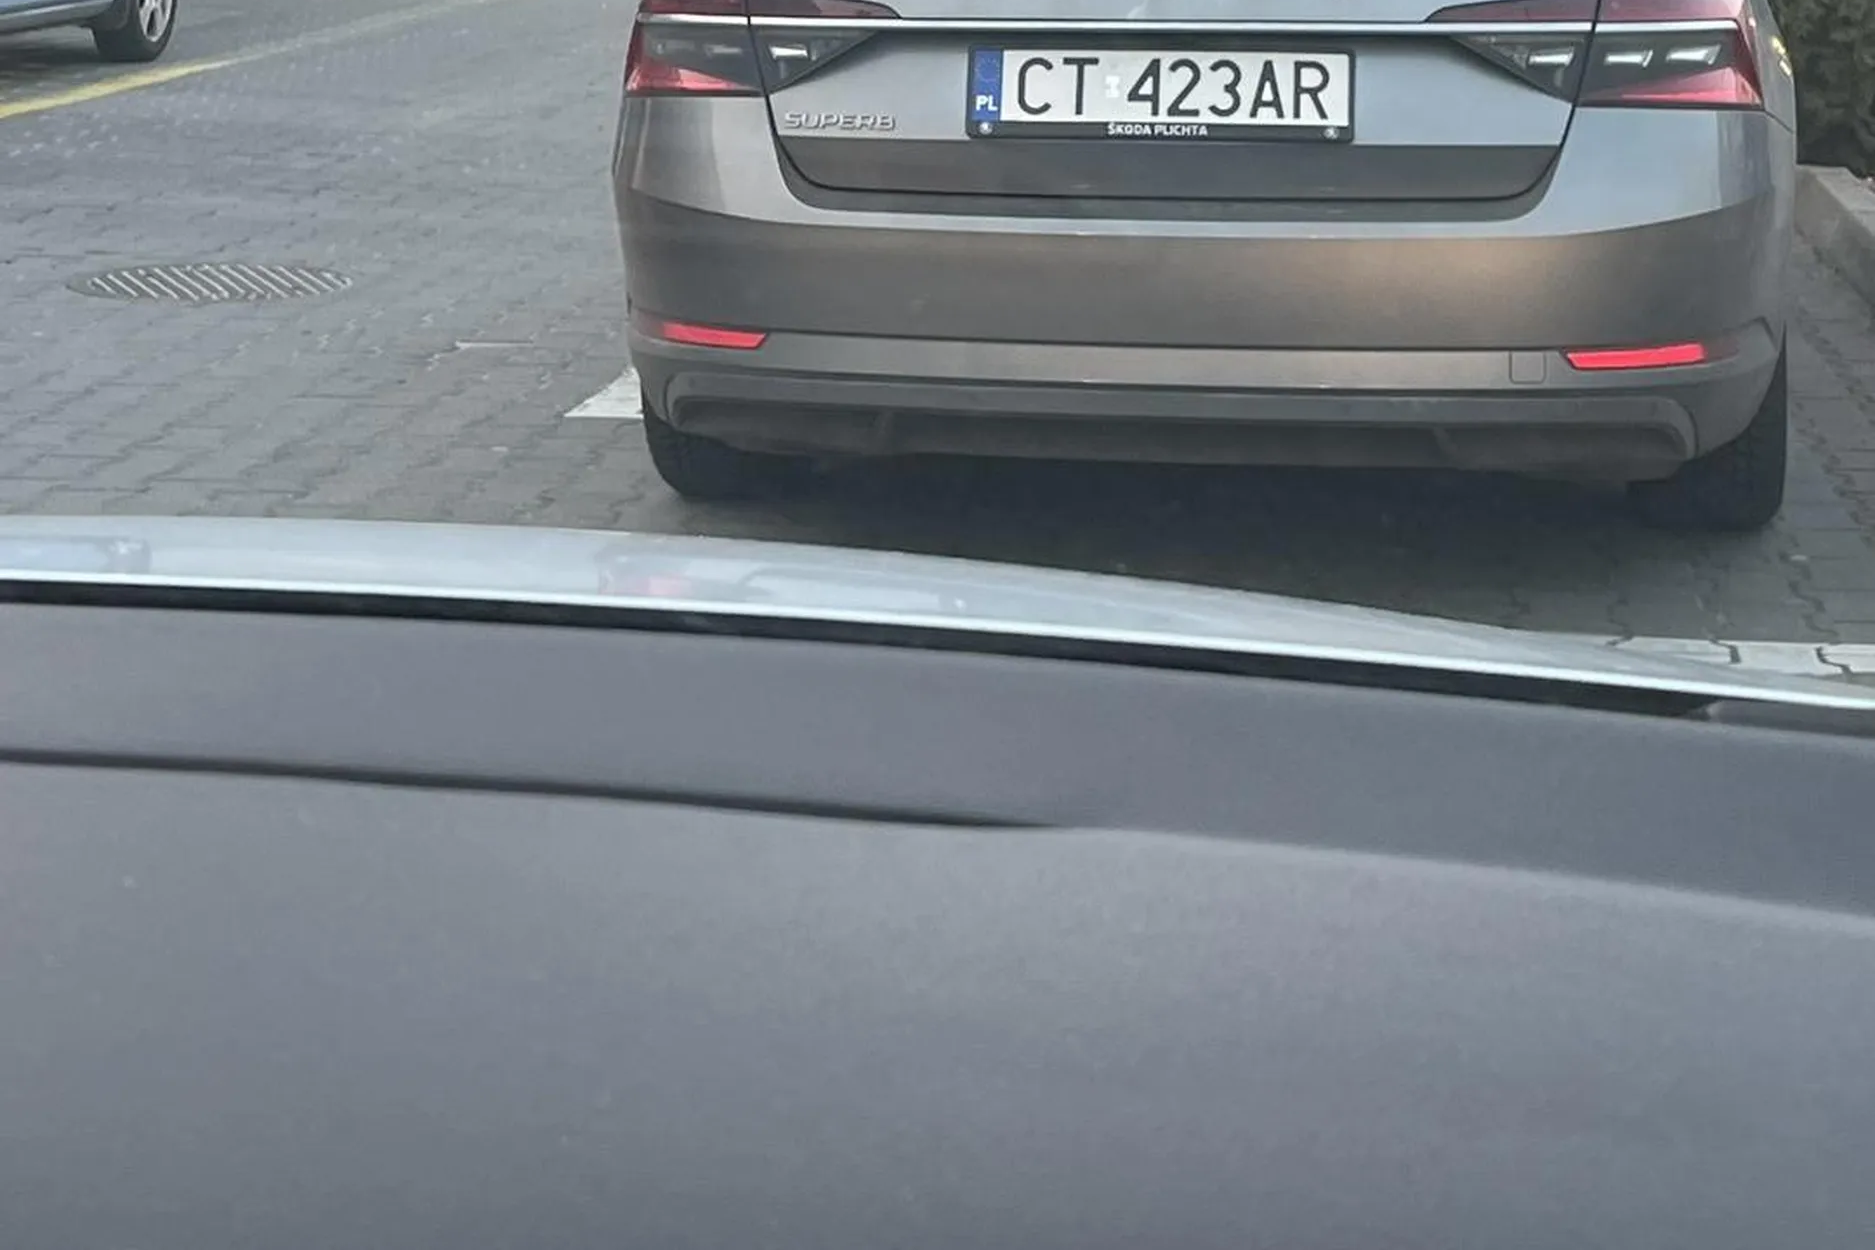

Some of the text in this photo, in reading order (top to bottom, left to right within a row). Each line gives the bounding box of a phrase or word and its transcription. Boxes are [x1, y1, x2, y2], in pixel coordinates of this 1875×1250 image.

[1017, 57, 1330, 120] CT 423AR
[975, 95, 998, 111] PL
[784, 111, 896, 131] SUPERB
[1107, 122, 1209, 137] ŠKODA PLICHTA
